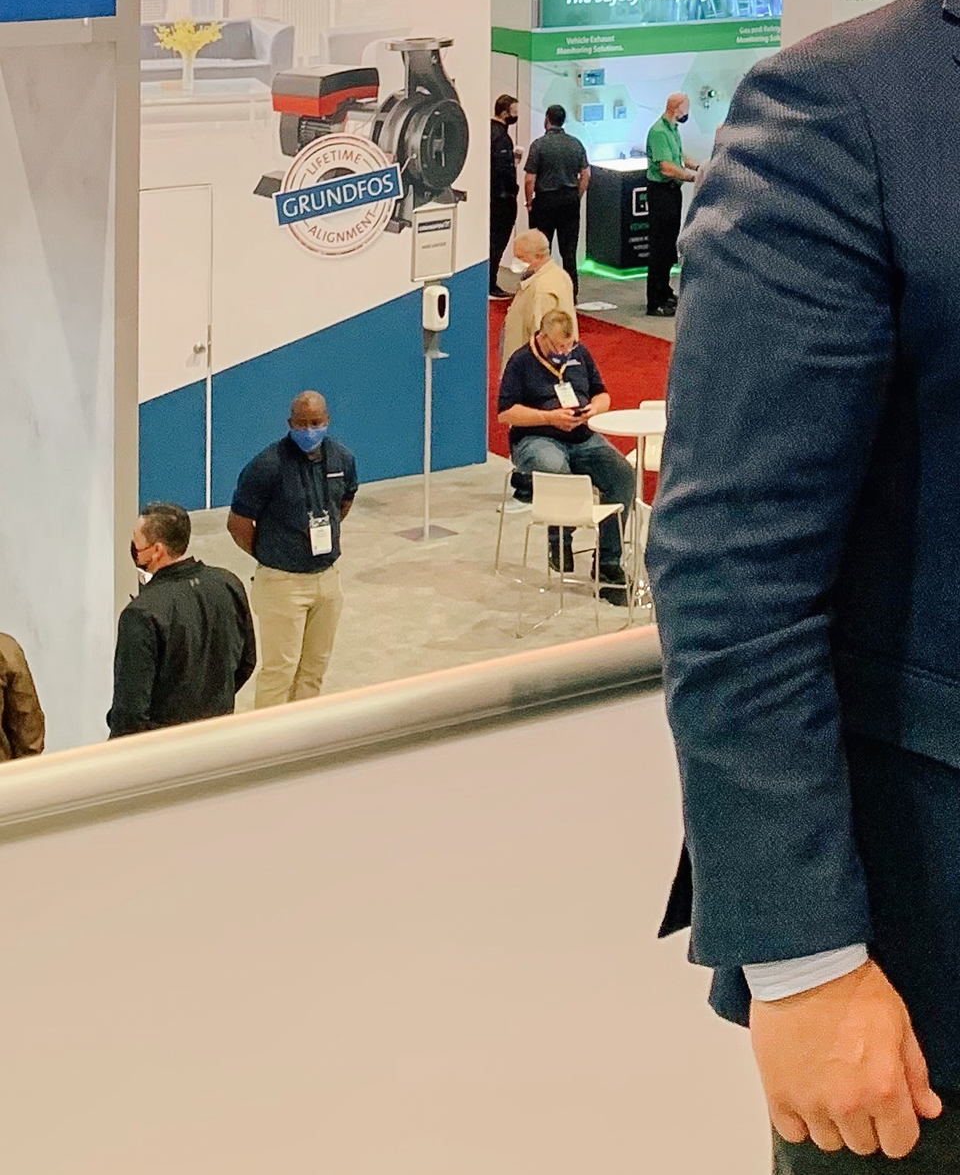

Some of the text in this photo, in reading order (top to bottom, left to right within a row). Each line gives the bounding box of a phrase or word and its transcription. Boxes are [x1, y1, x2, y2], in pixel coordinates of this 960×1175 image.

[306, 149, 363, 175] LIFETIME
[282, 172, 394, 217] GRUNDFOS
[308, 211, 376, 243] ALIGNMENT
